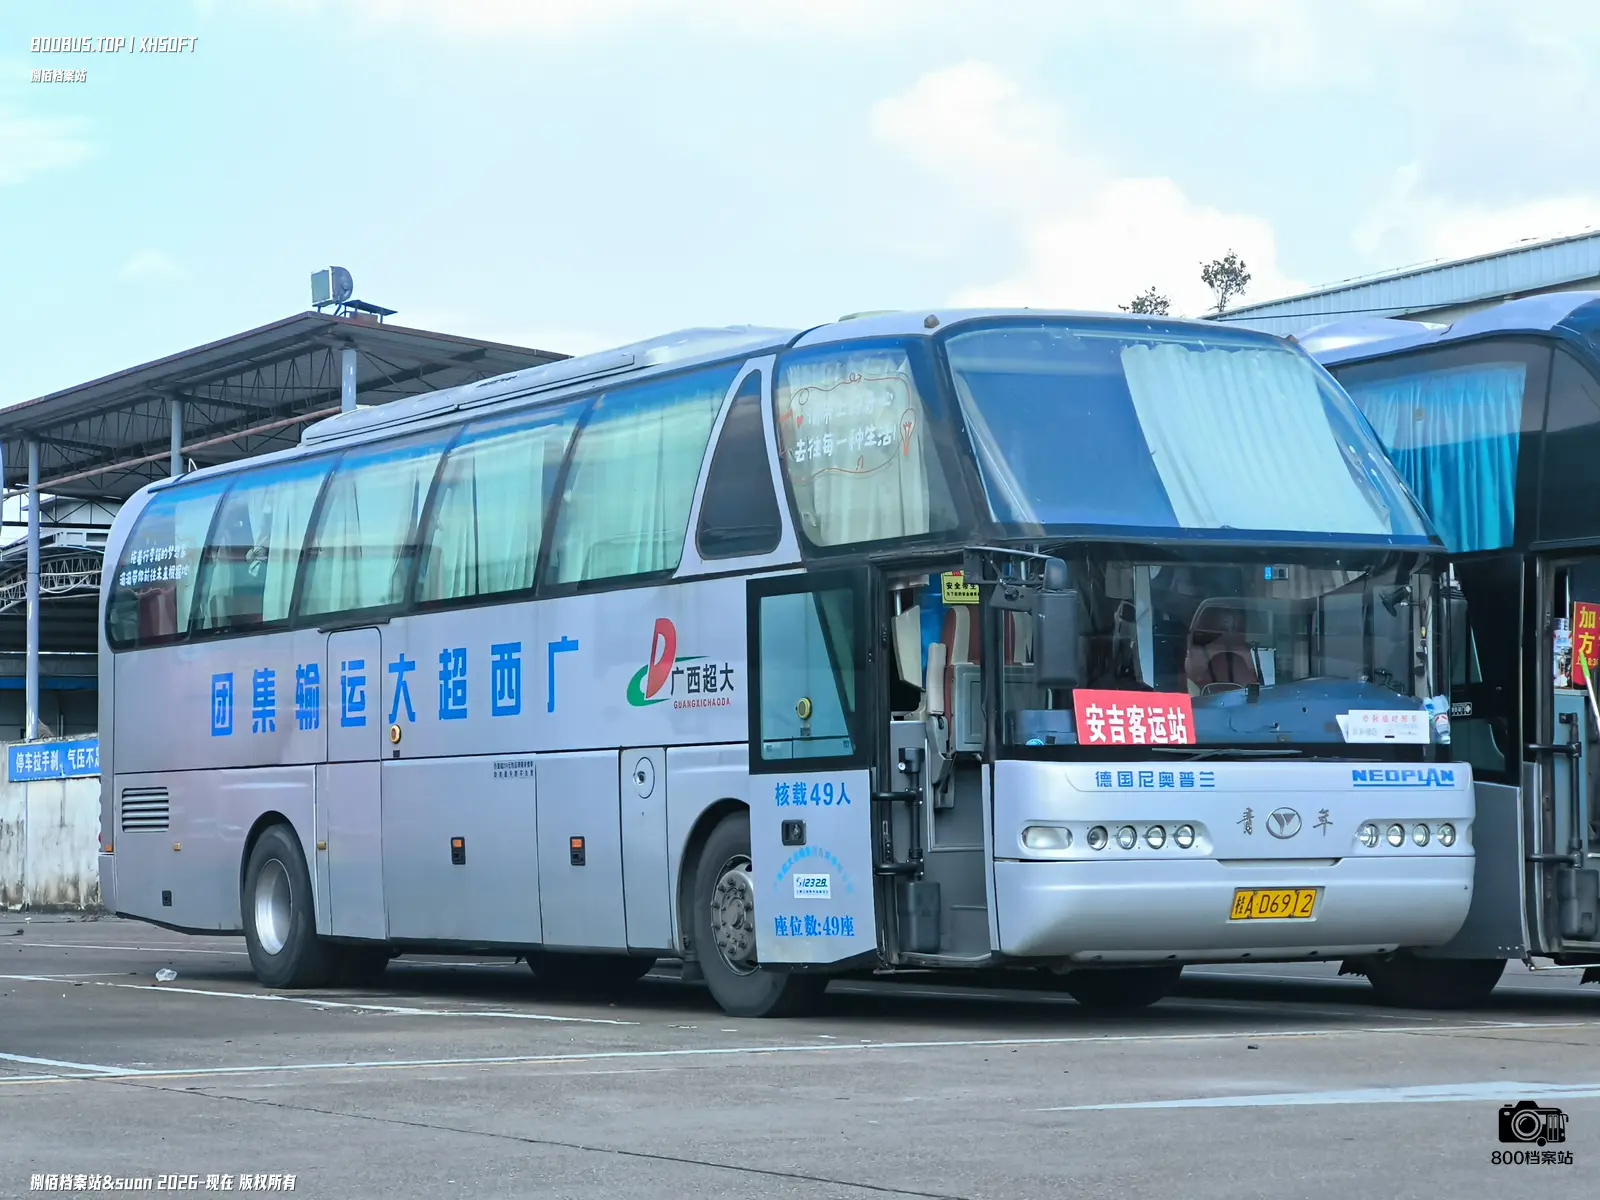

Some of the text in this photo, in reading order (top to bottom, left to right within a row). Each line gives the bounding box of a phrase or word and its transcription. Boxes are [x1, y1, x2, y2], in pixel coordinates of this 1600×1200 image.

[670, 662, 734, 696] 广西超大
[673, 698, 731, 709] GUANGXICHAODA
[1085, 703, 1188, 744] 安吉客运站
[1095, 770, 1215, 788] 德国尼奥普兰
[1351, 768, 1455, 787] NEOPLAN
[775, 781, 851, 806] 核载49人
